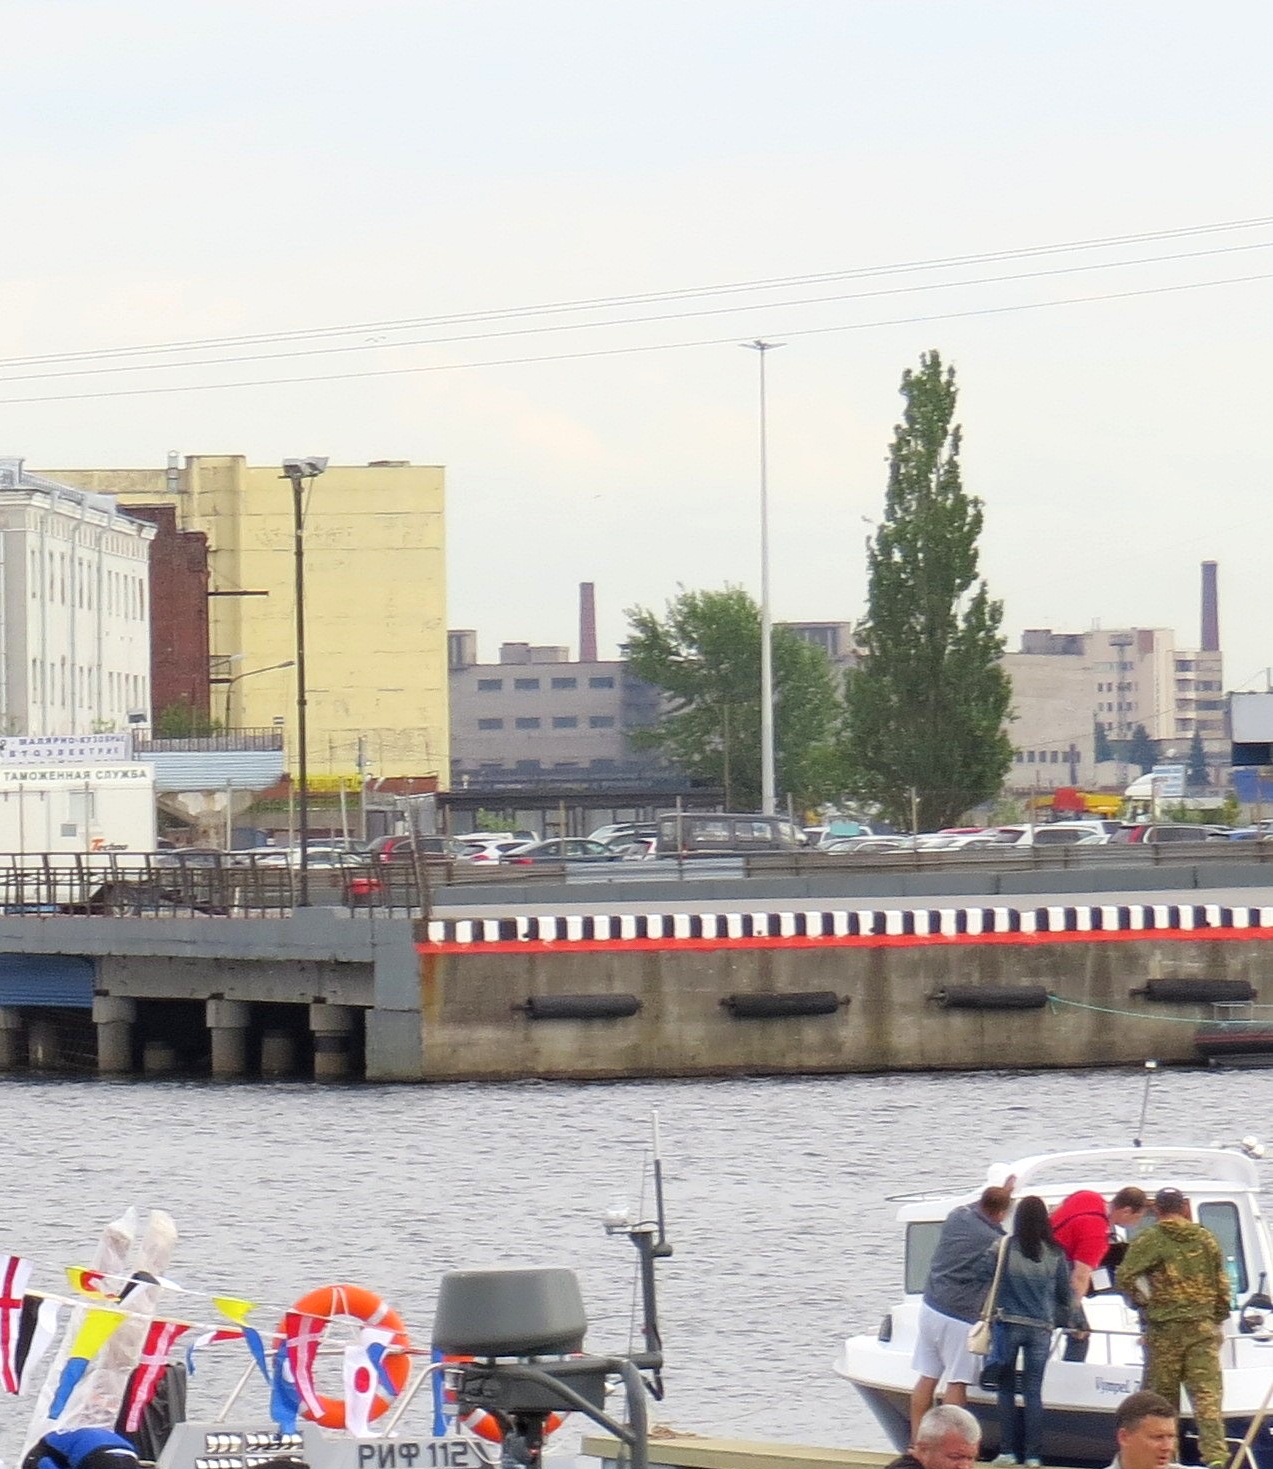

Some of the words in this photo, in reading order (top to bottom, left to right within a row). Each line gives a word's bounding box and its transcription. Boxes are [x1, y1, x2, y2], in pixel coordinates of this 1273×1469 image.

[4, 770, 91, 782] ТАМОЖЕННАЯ
[95, 769, 147, 780] СЛУЖБА
[358, 1442, 420, 1469] РИФ
[426, 1441, 469, 1467] 112
